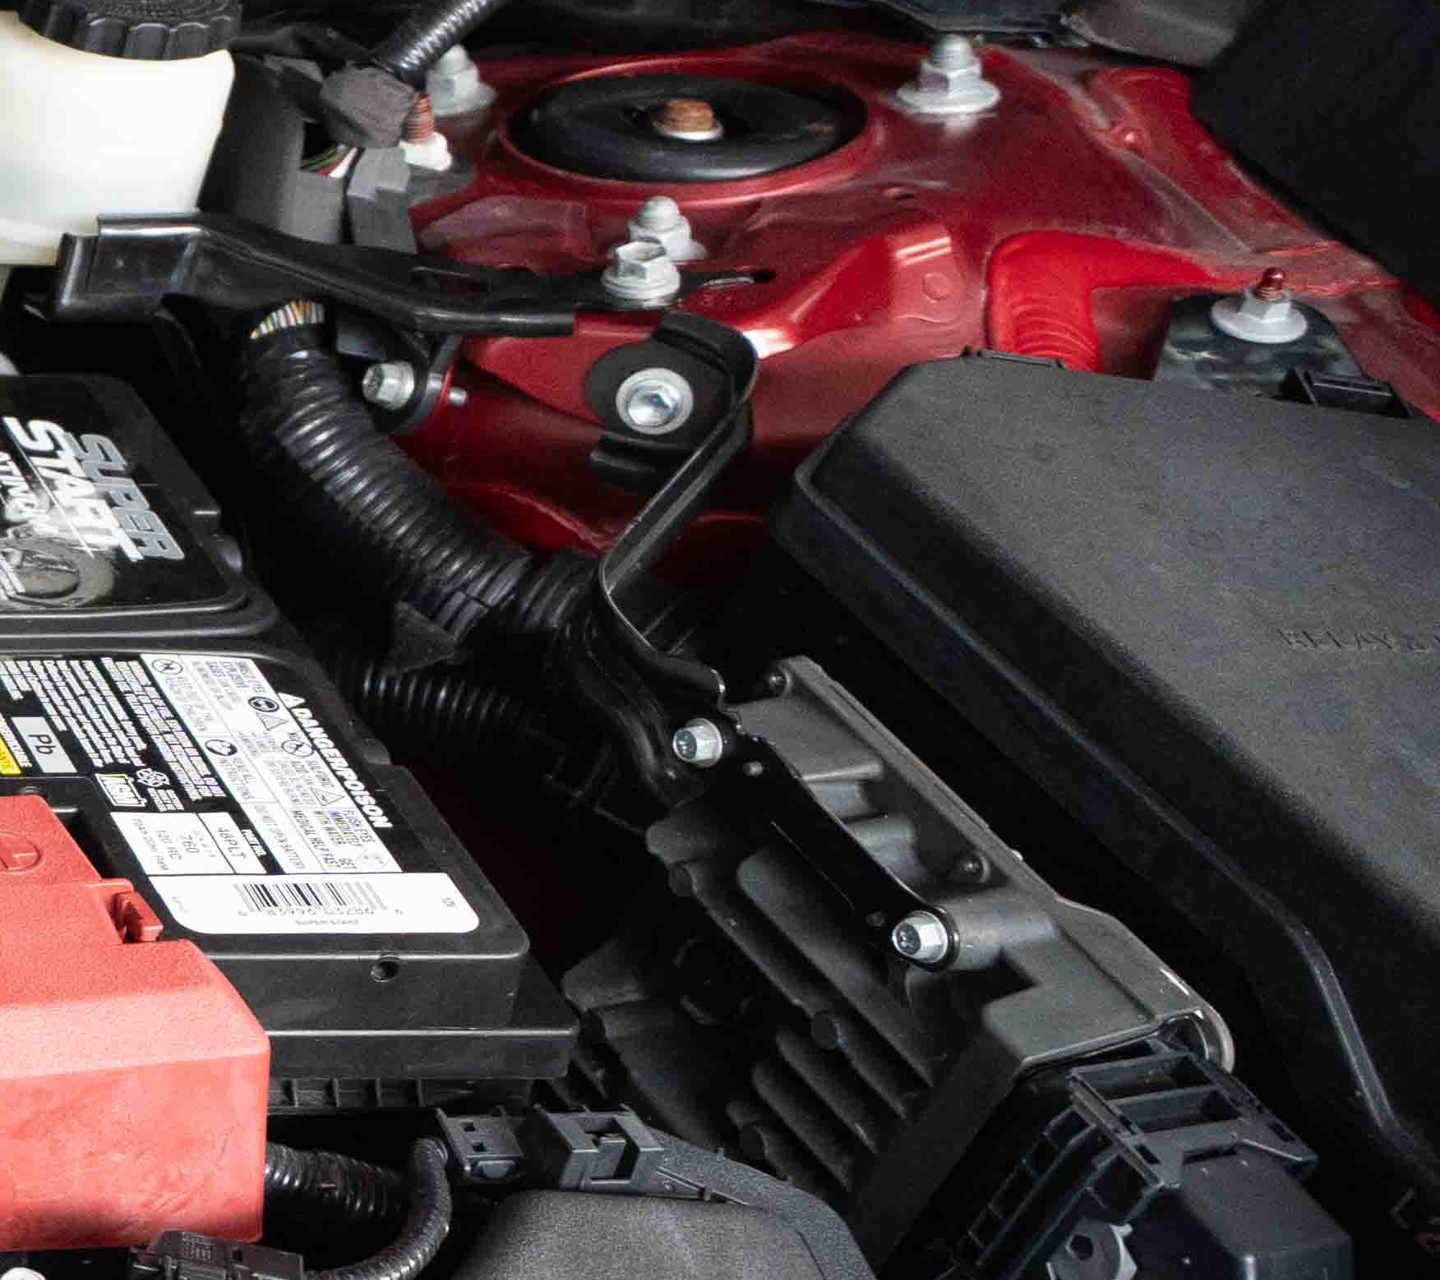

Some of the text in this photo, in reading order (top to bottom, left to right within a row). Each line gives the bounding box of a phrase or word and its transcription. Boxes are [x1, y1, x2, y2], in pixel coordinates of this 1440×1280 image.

[1, 416, 144, 563] START
[67, 432, 184, 560] SUPER
[27, 733, 56, 755] Pb
